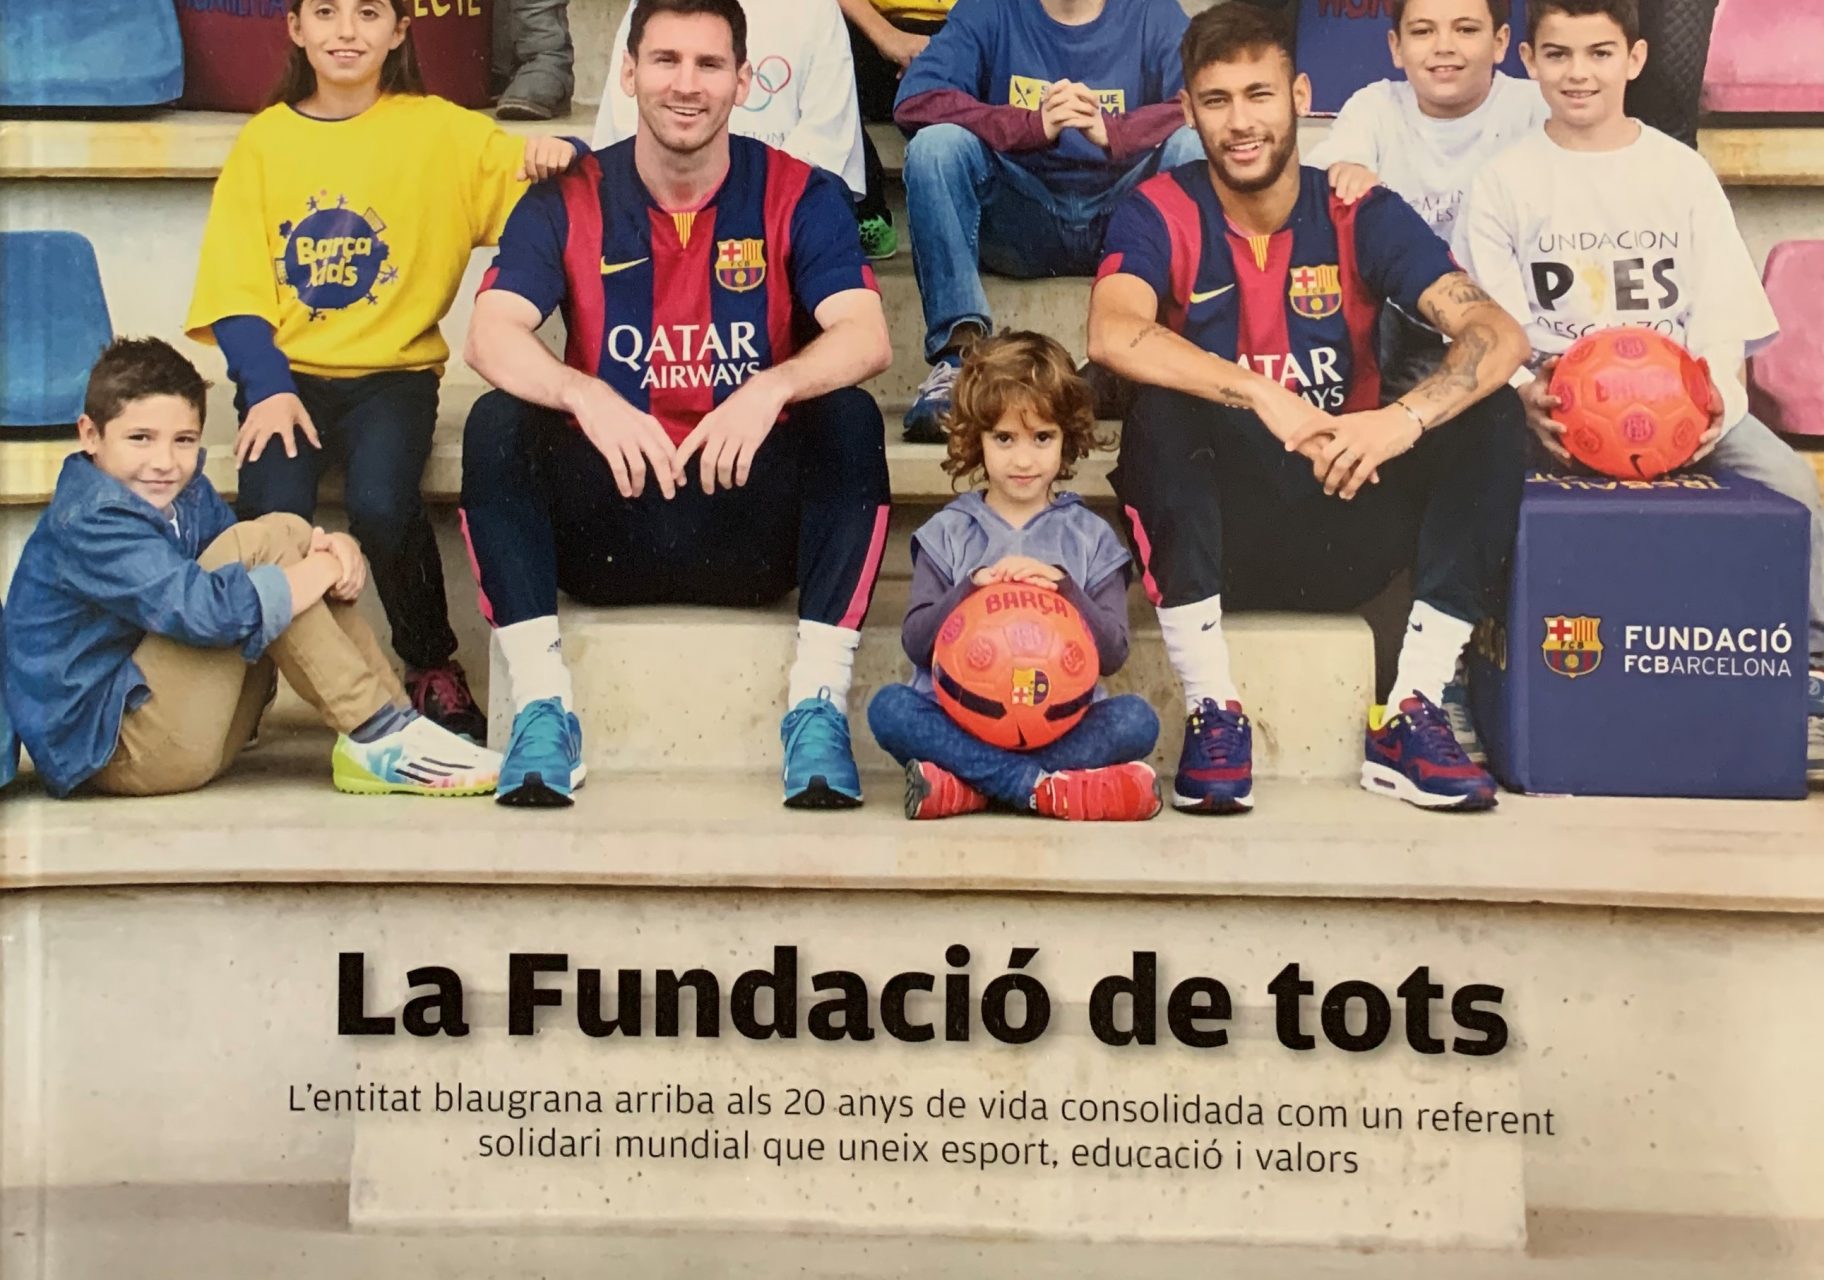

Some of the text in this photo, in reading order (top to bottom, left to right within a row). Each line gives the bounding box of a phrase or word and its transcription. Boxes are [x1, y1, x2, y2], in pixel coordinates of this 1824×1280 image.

[296, 236, 372, 266] Barça
[1539, 230, 1678, 253] UNDACION
[607, 321, 760, 372] QATAR
[1209, 346, 1343, 390] TAR
[985, 590, 1068, 618] BARÇA
[1560, 640, 1585, 650] FCB
[1625, 622, 1793, 654] FUNDACIÓ
[1624, 654, 1792, 677] FCBARCELONA
[337, 943, 1509, 1057] La Fundació de tots
[435, 1082, 602, 1119] blaugrana
[614, 1085, 714, 1115] arriba
[728, 1086, 771, 1116] als
[784, 1088, 825, 1116] 20
[838, 1093, 914, 1123] anys
[926, 1090, 967, 1119] de
[979, 1090, 1048, 1121] vida
[1061, 1093, 1263, 1127] consolidada
[1277, 1102, 1347, 1128] com
[1362, 1106, 1402, 1130] un
[1417, 1101, 1555, 1136] referent
[478, 1127, 1359, 1174] solidari mundial que uneix esport, educació i valors
